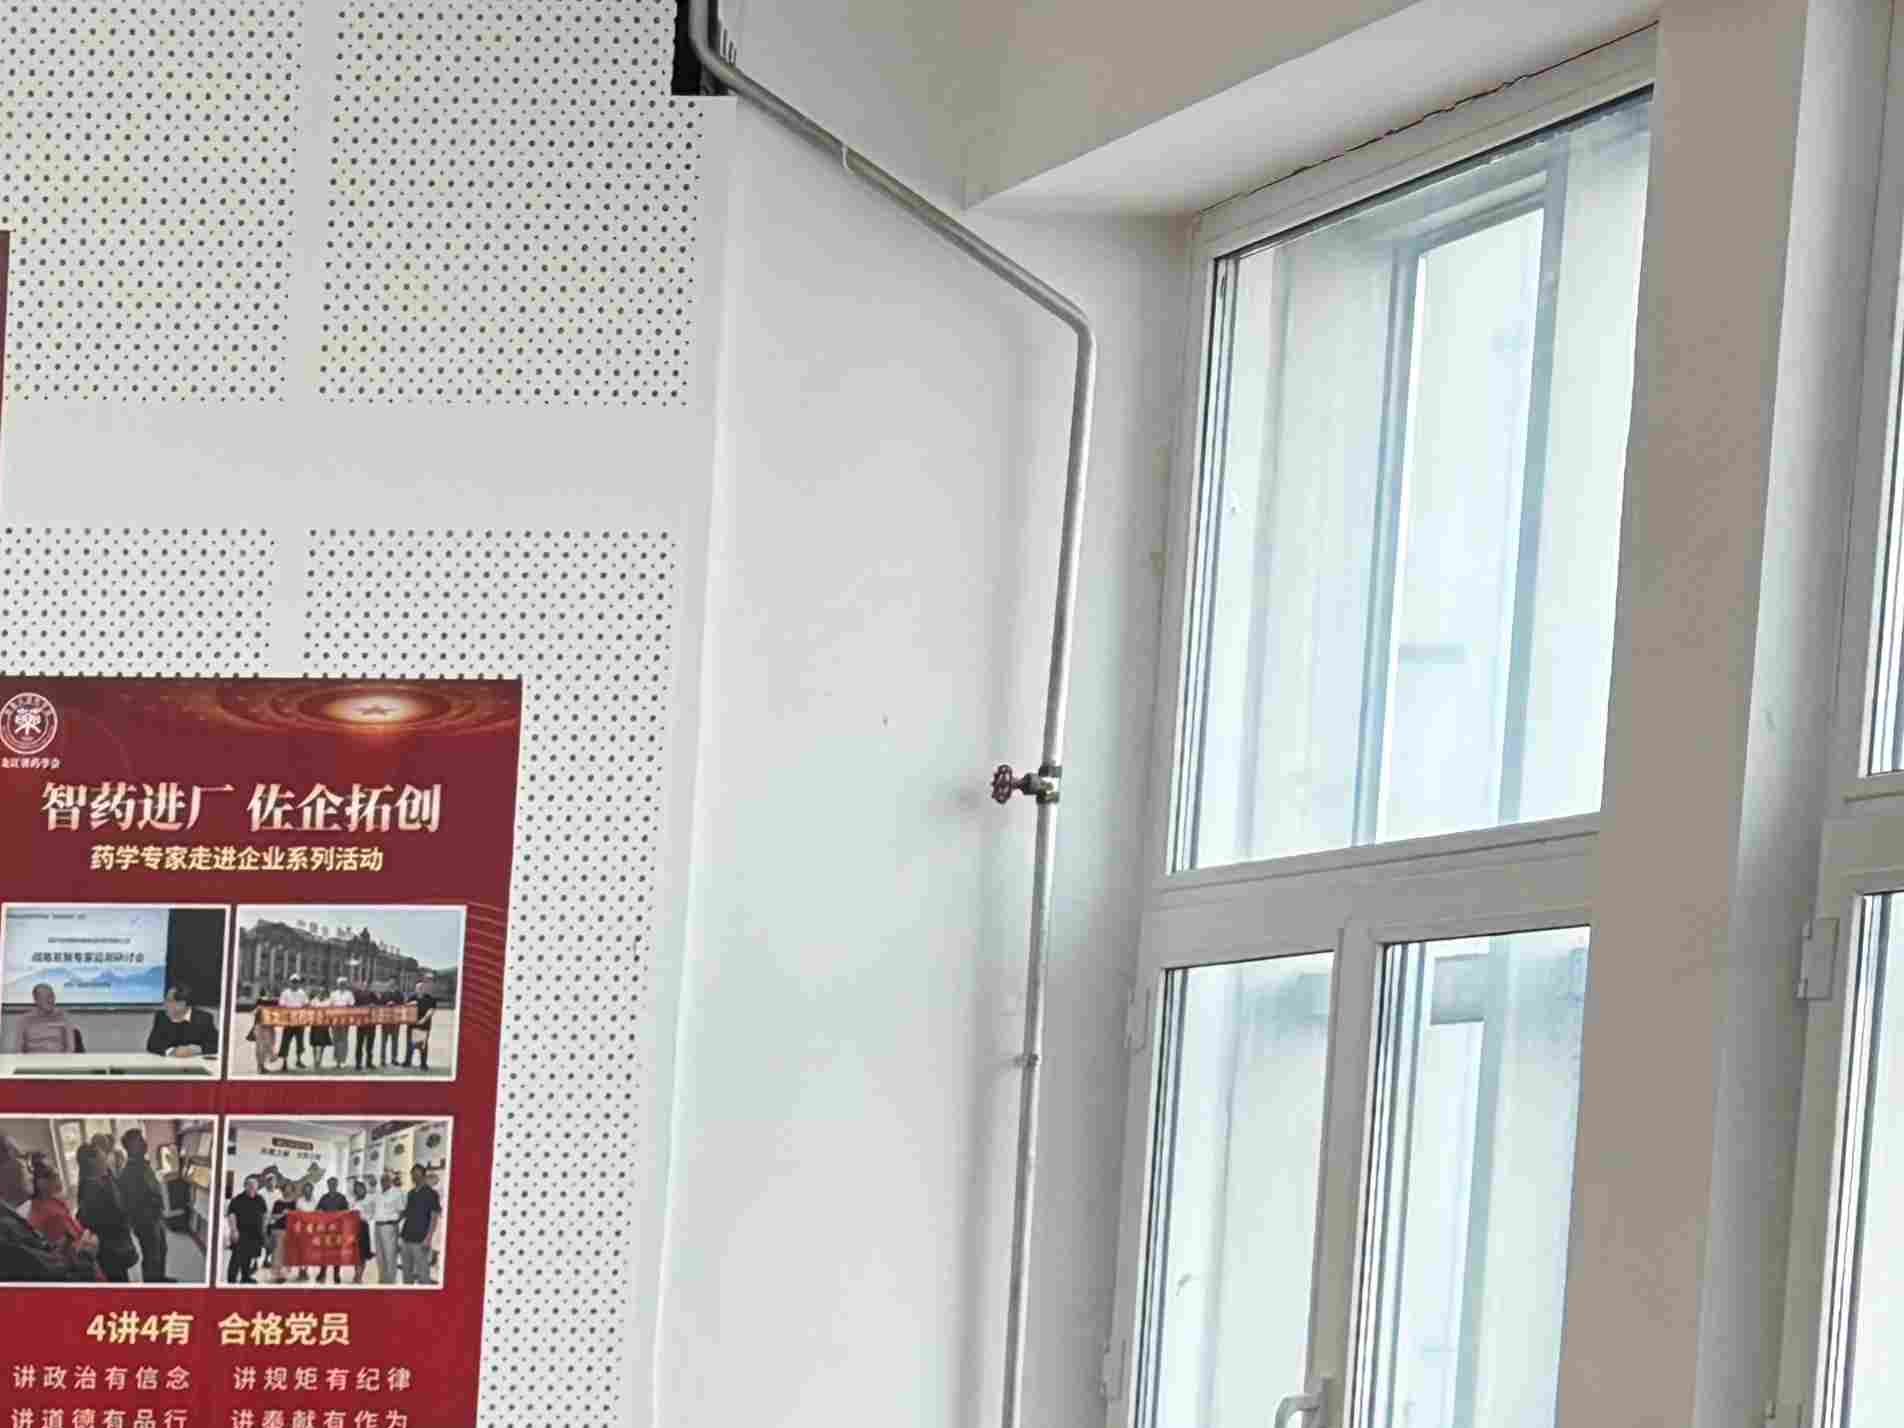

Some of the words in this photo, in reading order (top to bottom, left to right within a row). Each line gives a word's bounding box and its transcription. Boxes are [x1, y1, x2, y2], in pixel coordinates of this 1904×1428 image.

[40, 781, 237, 833] 智药进厂
[246, 783, 442, 833] 佐企拓创
[89, 845, 384, 872] 药学专家走进企业系列活动
[86, 1310, 192, 1345] 4讲4有
[218, 1312, 351, 1346] 合格党员
[12, 1365, 192, 1392] 讲政治有信念
[233, 1367, 412, 1392] 讲规矩有纪律
